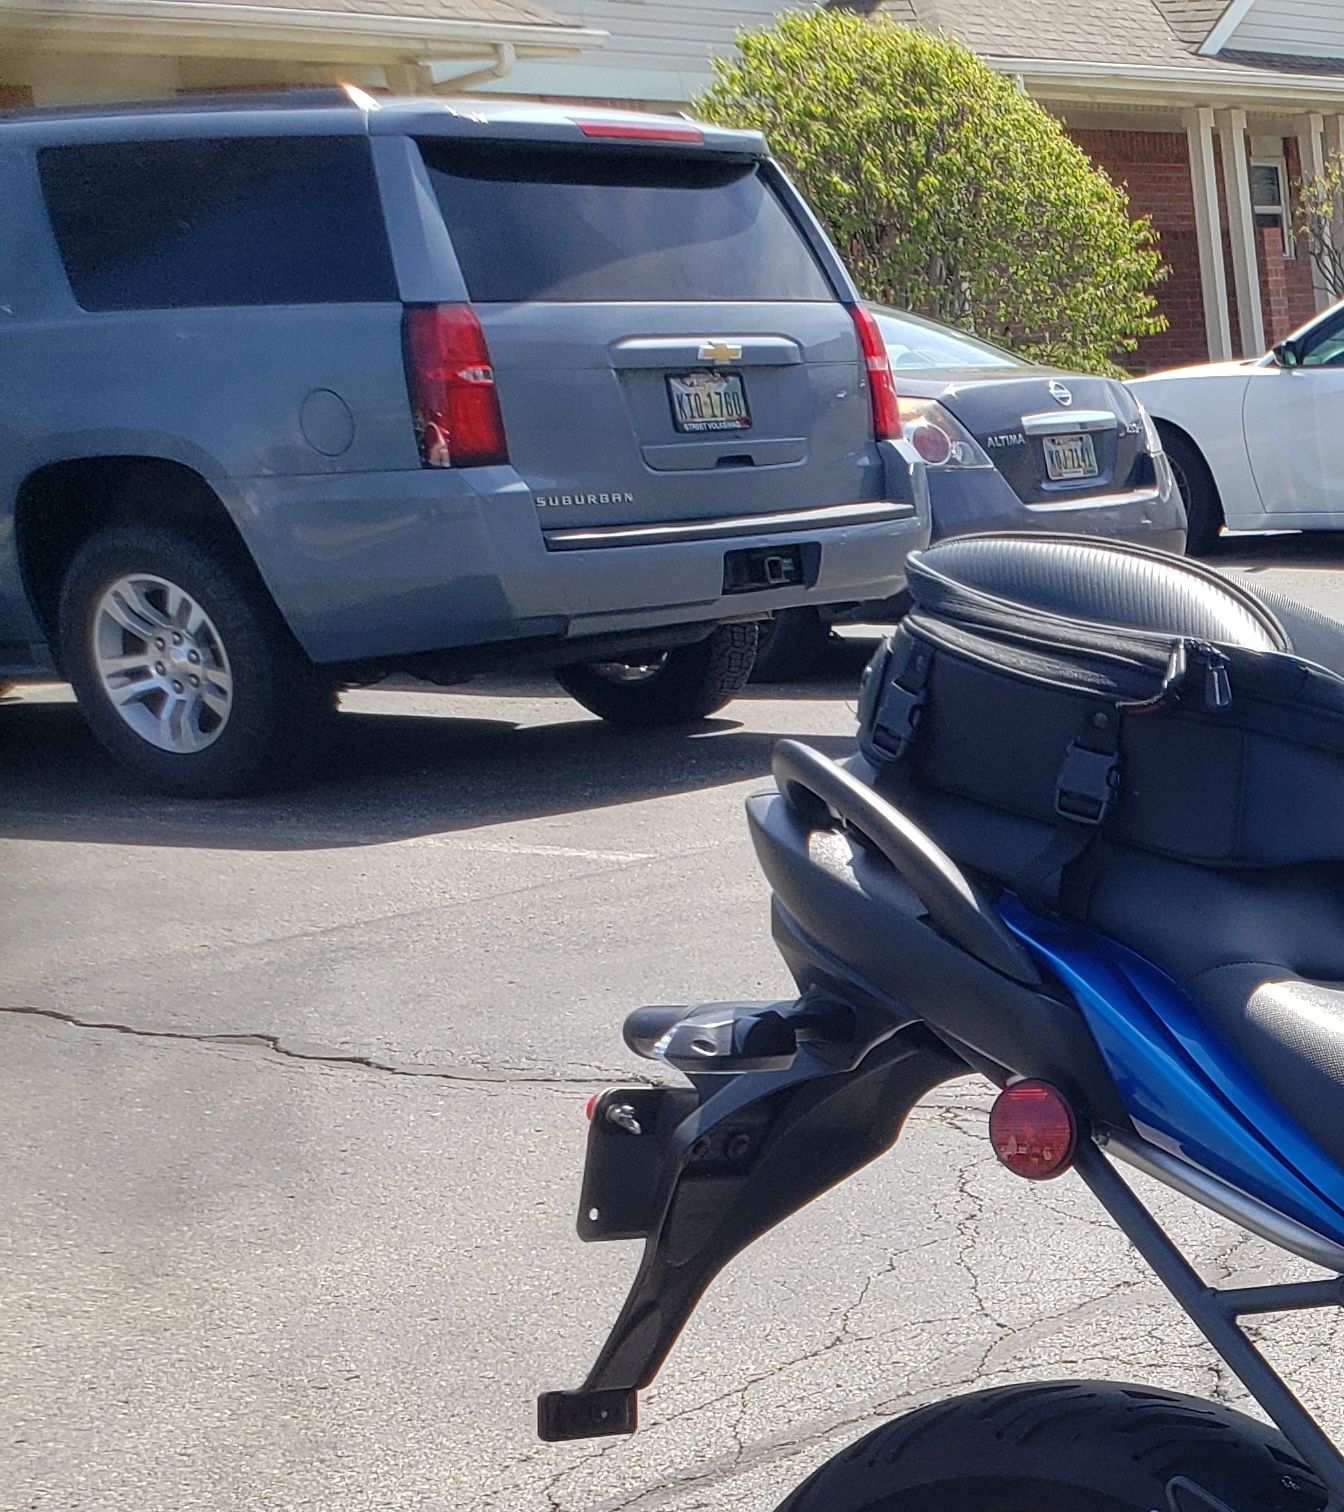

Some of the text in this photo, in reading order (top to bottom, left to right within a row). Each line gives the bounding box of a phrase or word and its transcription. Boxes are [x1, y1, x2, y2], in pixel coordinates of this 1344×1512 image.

[706, 391, 742, 418] 1760
[986, 433, 1026, 449] ALTIMA
[536, 492, 634, 508] SUBURBAN
